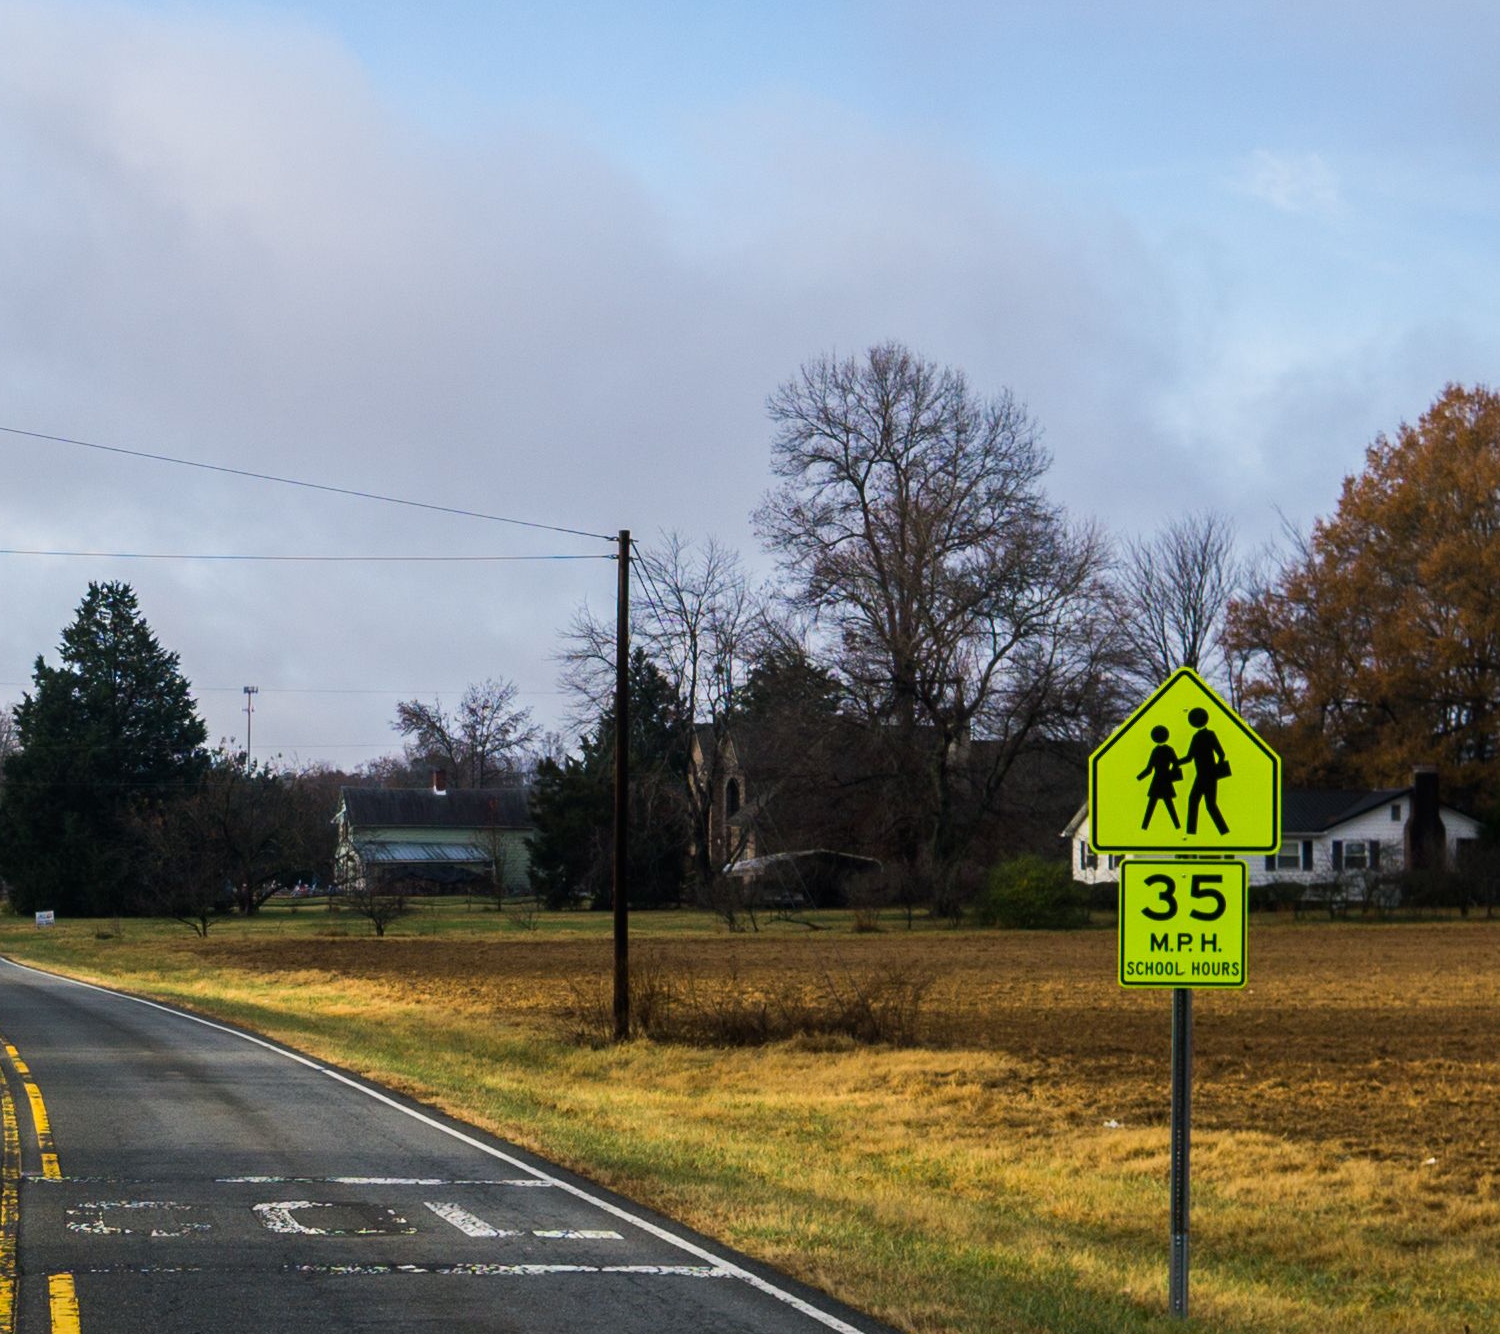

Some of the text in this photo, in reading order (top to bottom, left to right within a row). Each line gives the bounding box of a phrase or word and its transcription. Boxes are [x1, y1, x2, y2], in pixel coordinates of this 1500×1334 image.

[1141, 874, 1226, 921] 35
[1126, 961, 1240, 976] SCHOOL HOURS
